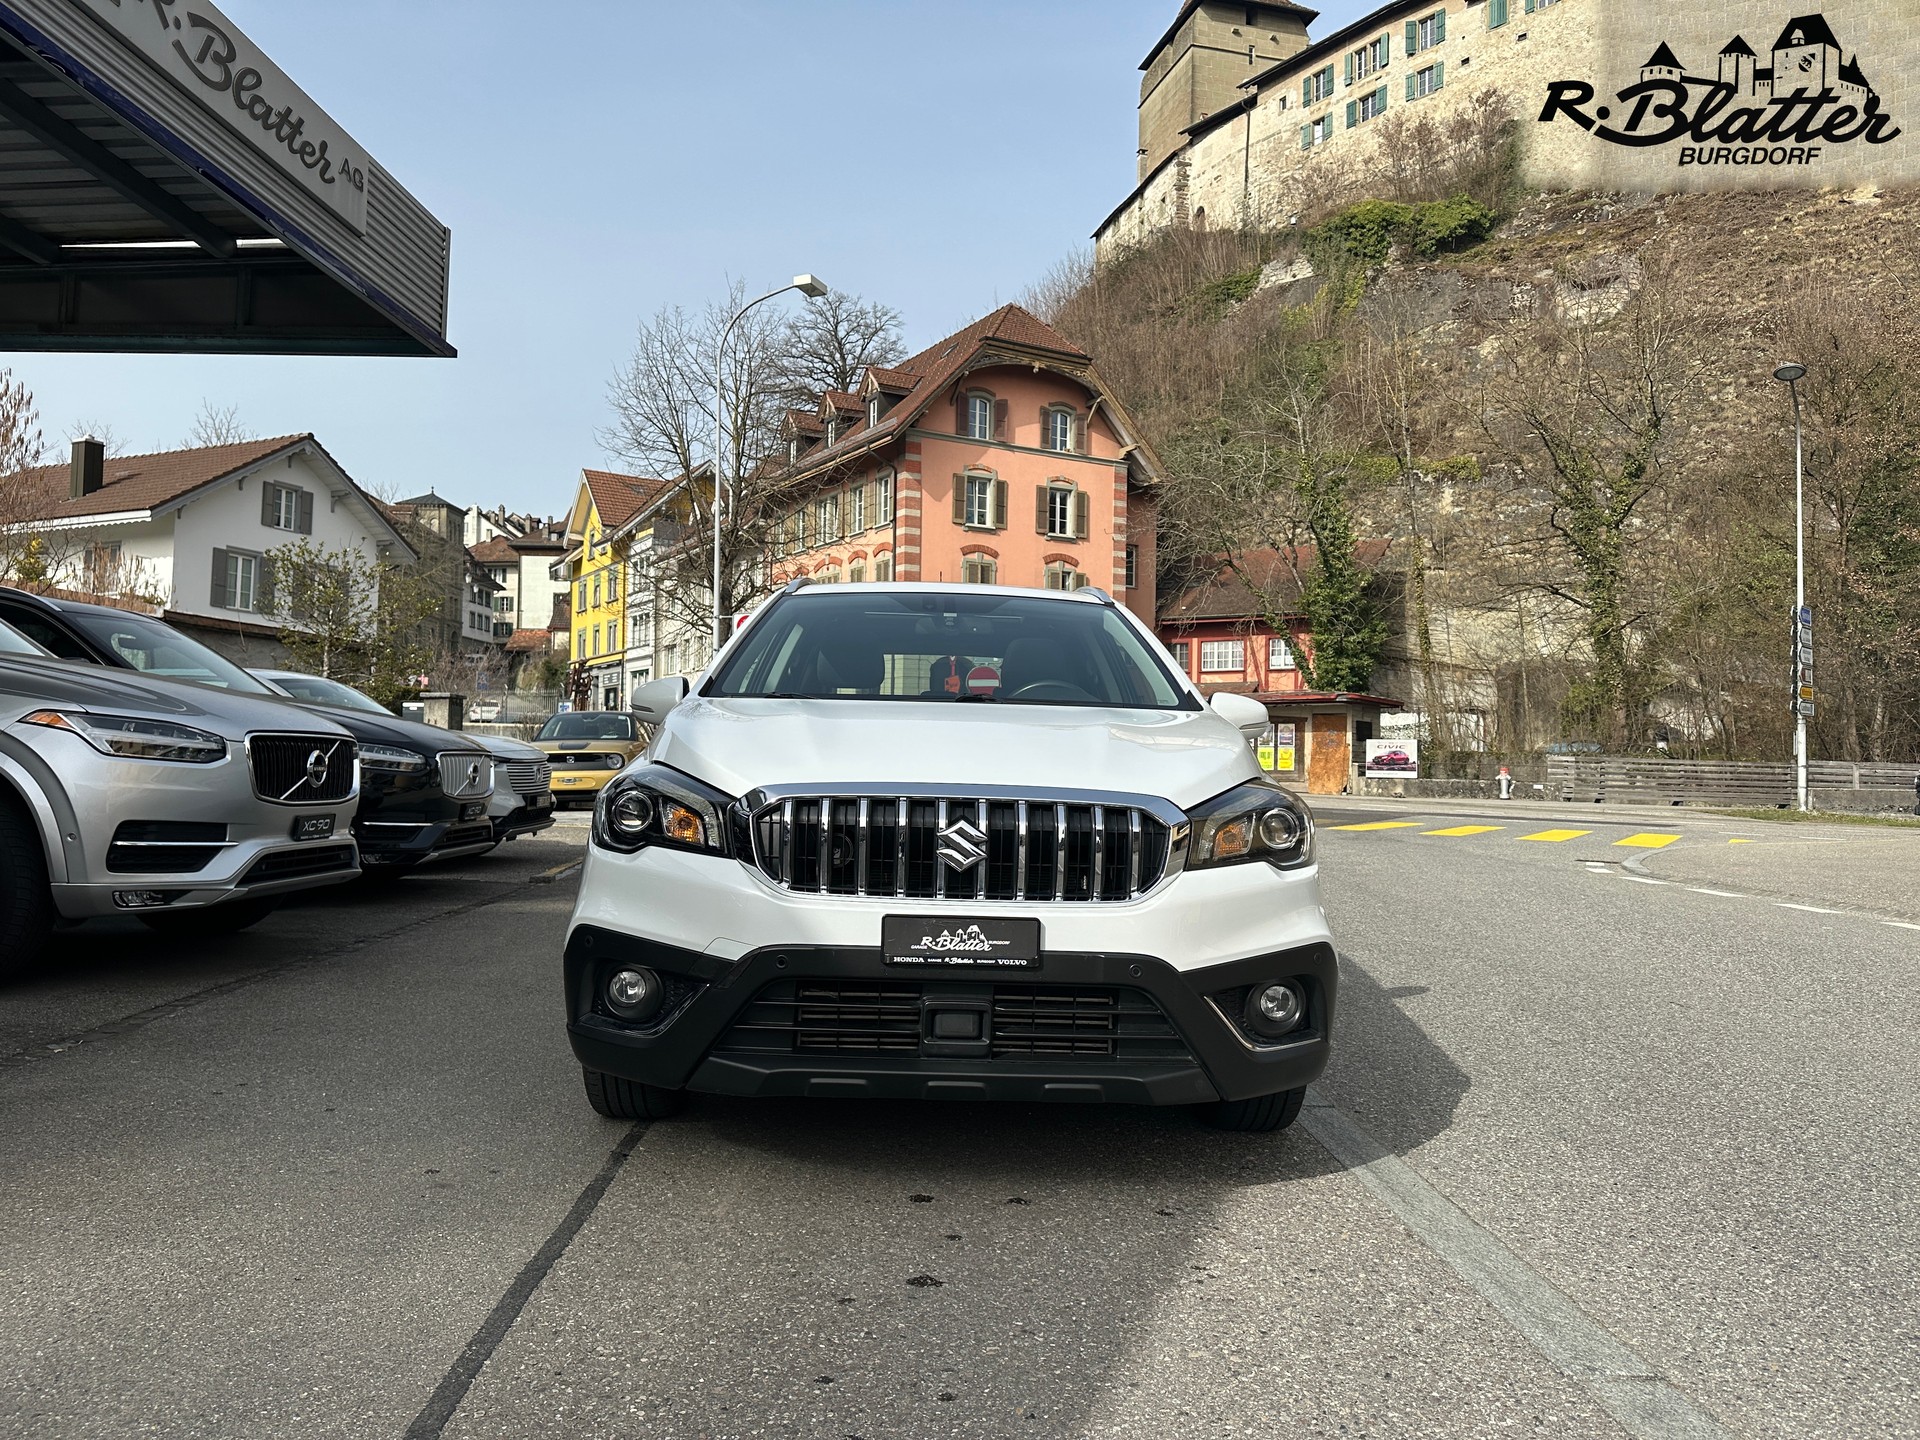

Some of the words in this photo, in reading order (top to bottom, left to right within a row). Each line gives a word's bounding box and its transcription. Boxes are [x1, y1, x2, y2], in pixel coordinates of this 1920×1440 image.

[172, 11, 336, 184] Blatter
[338, 157, 364, 192] AG
[302, 820, 317, 832] XC
[932, 936, 992, 951] Blatter
